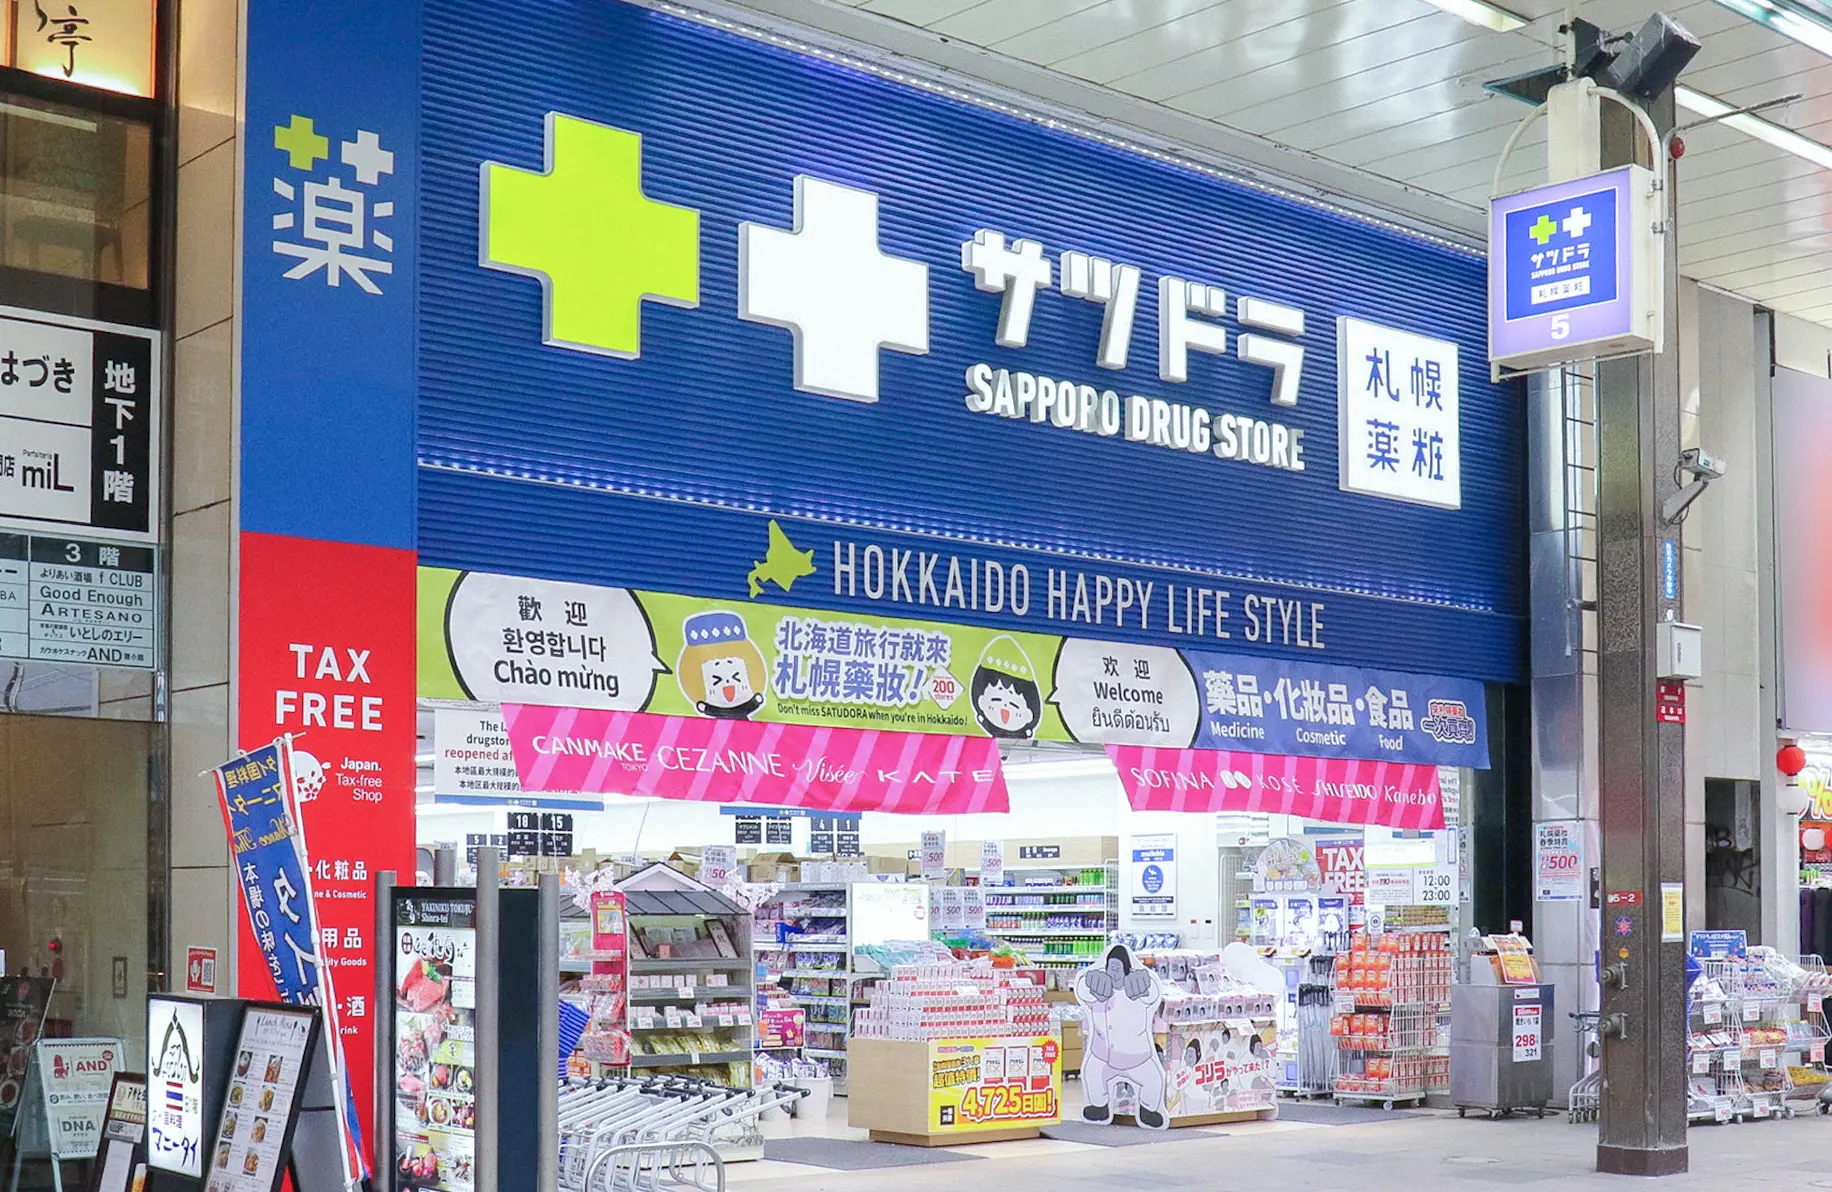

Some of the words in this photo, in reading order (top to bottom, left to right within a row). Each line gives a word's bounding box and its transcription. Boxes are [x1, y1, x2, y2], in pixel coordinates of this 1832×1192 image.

[1530, 242, 1590, 269] サツドラ
[961, 229, 1305, 406] サツドラ
[1551, 313, 1570, 339] 5
[964, 363, 1120, 436] SAPPORO
[1124, 395, 1211, 453] DRUG
[1212, 414, 1305, 471] STORE
[104, 360, 136, 504] 地下1階
[40, 568, 92, 583] よりあい酒場
[109, 572, 143, 587] CLUB
[40, 586, 81, 601] Good
[87, 589, 143, 606] Enough
[834, 541, 1029, 615] HOKKAIDO
[1047, 570, 1153, 629] HAPPY
[1168, 584, 1231, 639] LIFE
[1243, 595, 1325, 649] STYLE
[41, 603, 142, 623] ARTESANO
[70, 627, 143, 642] いとしのエリー
[779, 620, 948, 663] 北海道旅行就來
[502, 627, 606, 662] 환영합니다
[87, 647, 122, 662] AND
[289, 643, 371, 684] TAX
[494, 660, 551, 685] Chào
[558, 664, 619, 697] mừng
[932, 679, 955, 694] 200
[1093, 681, 1163, 704] Welcome
[275, 690, 384, 731] FREE
[778, 703, 800, 714] Don't
[801, 706, 820, 716] miss
[821, 708, 868, 719] SATUDORA
[869, 711, 889, 721] when
[890, 713, 916, 724] you're
[917, 714, 925, 723] in
[927, 715, 968, 726] Hokkaido!
[480, 720, 499, 732] The
[1092, 706, 1170, 732] ยินดีต้อนรับ
[1210, 720, 1265, 740] Medicine
[1295, 726, 1347, 746] Cosmetic
[1379, 733, 1403, 751] Food
[445, 749, 499, 761] reopened
[532, 735, 648, 762] CANMAKE
[657, 745, 785, 778] CEZANNE
[791, 756, 868, 785] Visée
[878, 769, 995, 784] KATE
[341, 757, 382, 772] Japan.
[621, 762, 649, 772] TOKYO
[336, 772, 382, 788] Tax-free
[1130, 767, 1214, 789] SOFINA
[1311, 778, 1377, 800] SHISEIDO
[1383, 785, 1436, 805] Kanebo
[352, 788, 382, 802] Shop
[551, 815, 563, 829] 15
[819, 818, 825, 830] 4
[845, 819, 850, 830] 1
[498, 836, 503, 844] 2
[929, 852, 944, 862] 500
[987, 858, 1001, 867] 500
[1322, 847, 1364, 871] TAX
[1549, 855, 1577, 870] 500
[1423, 875, 1450, 886] 12:00
[325, 890, 331, 898] &
[332, 889, 367, 899] Cosmetic
[1423, 890, 1450, 901] 23:00
[421, 902, 449, 913] YAKINIKU
[947, 906, 960, 915] 500
[968, 906, 982, 915] 500
[341, 957, 367, 967] Goods
[340, 1026, 359, 1034] rink
[1515, 1034, 1536, 1047] 298
[1525, 1049, 1537, 1057] 321
[76, 1061, 107, 1072] AND
[62, 1121, 96, 1132] DNA
